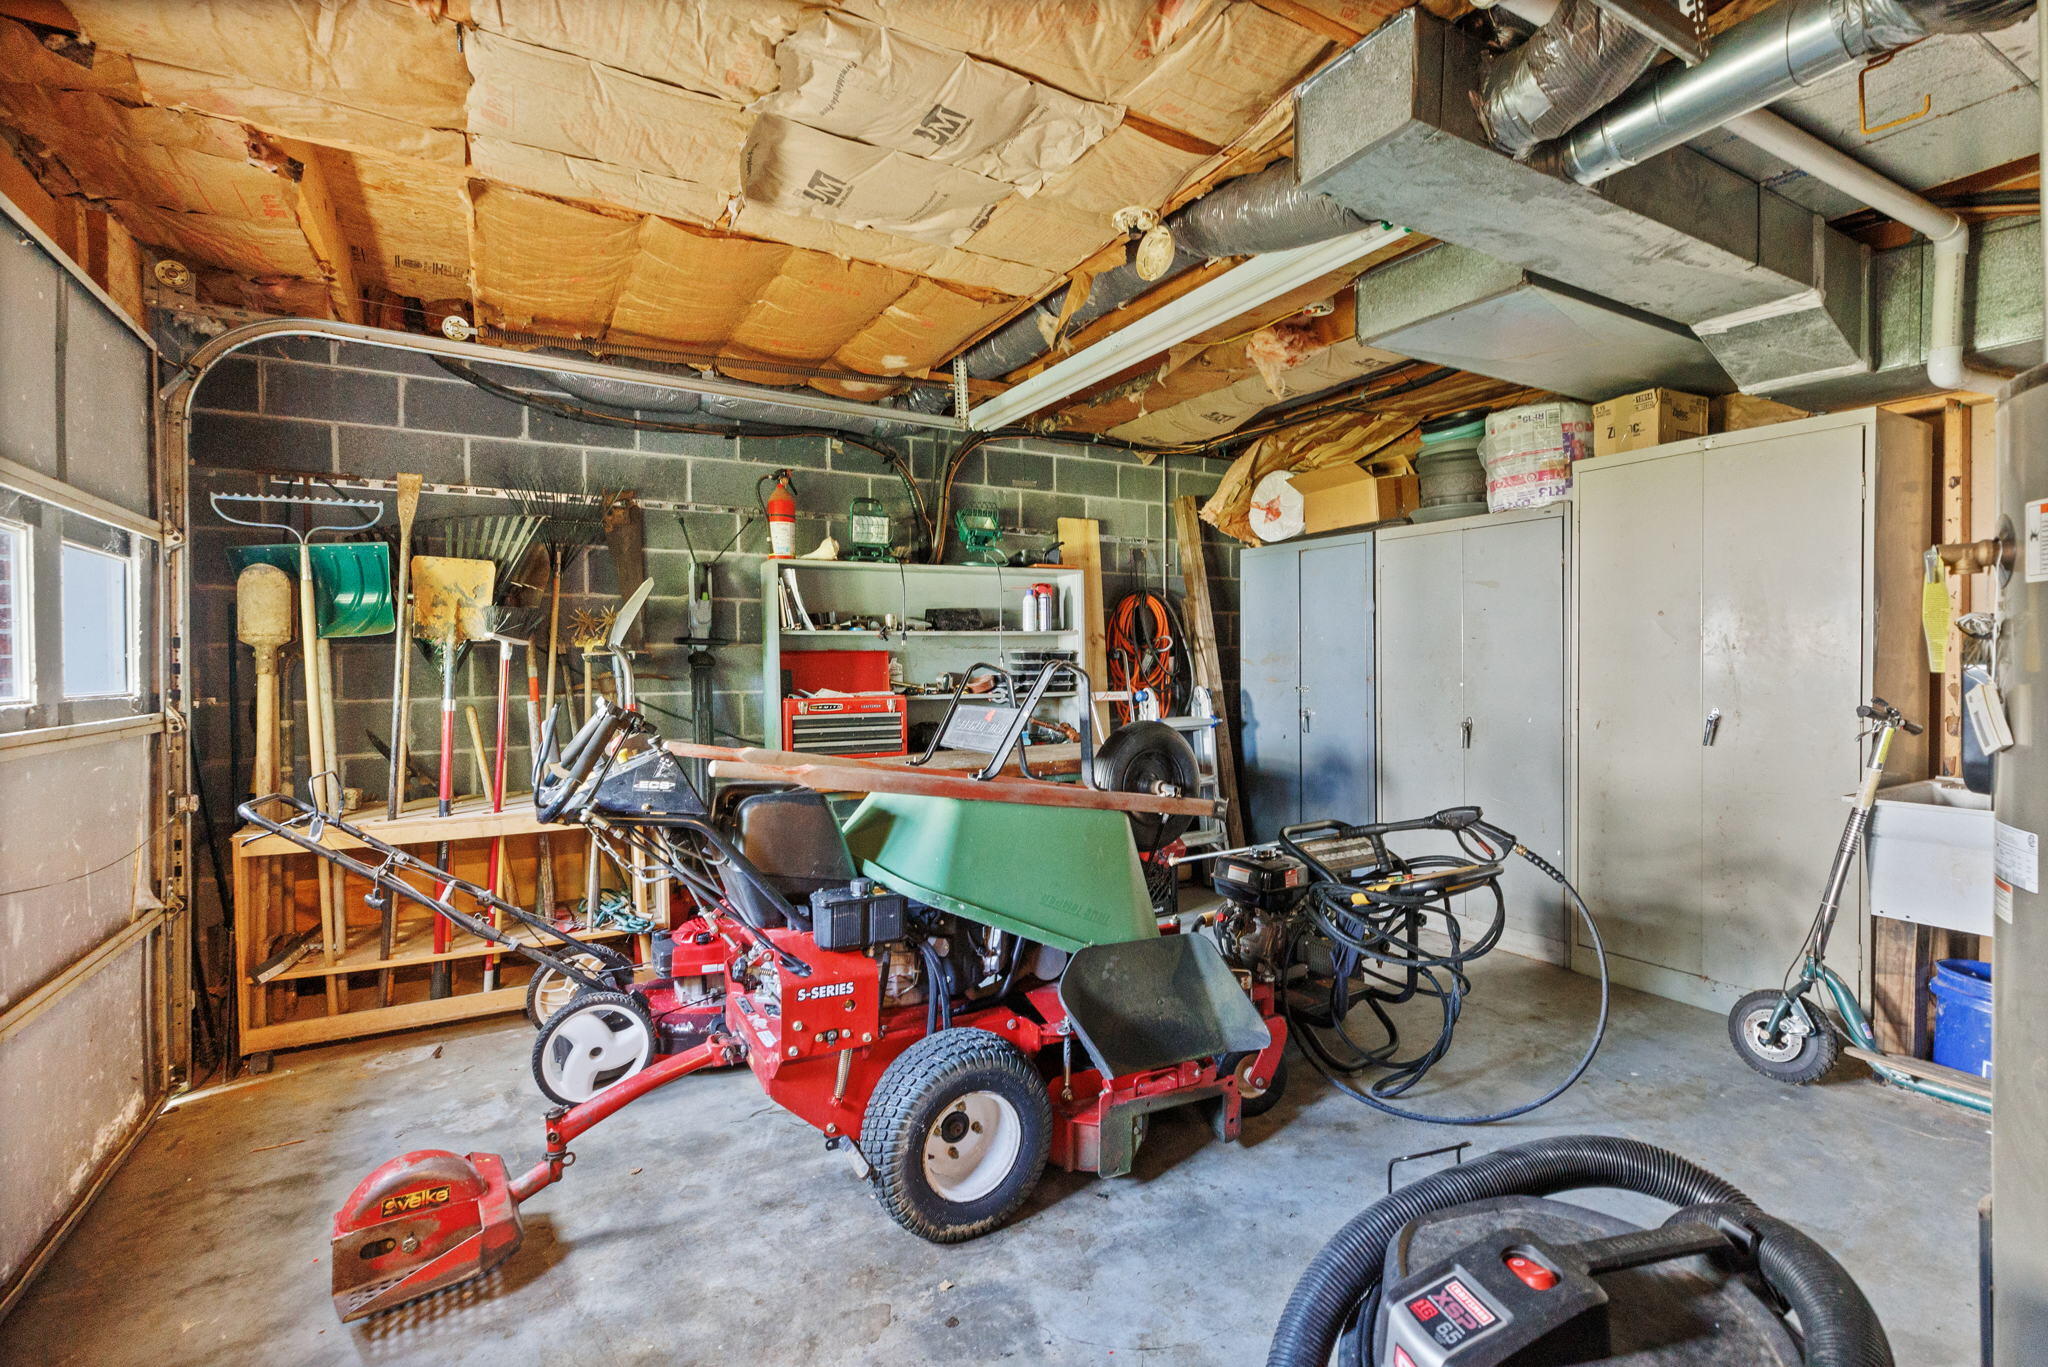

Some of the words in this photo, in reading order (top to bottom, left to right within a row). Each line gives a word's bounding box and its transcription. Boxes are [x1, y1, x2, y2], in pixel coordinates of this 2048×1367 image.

[912, 104, 967, 146] JM
[802, 169, 847, 206] JM
[797, 982, 854, 1001] S-SERIES
[1414, 1301, 1435, 1318] 16
[1433, 1290, 1477, 1330] XSP
[1436, 1322, 1463, 1345] 6.5
